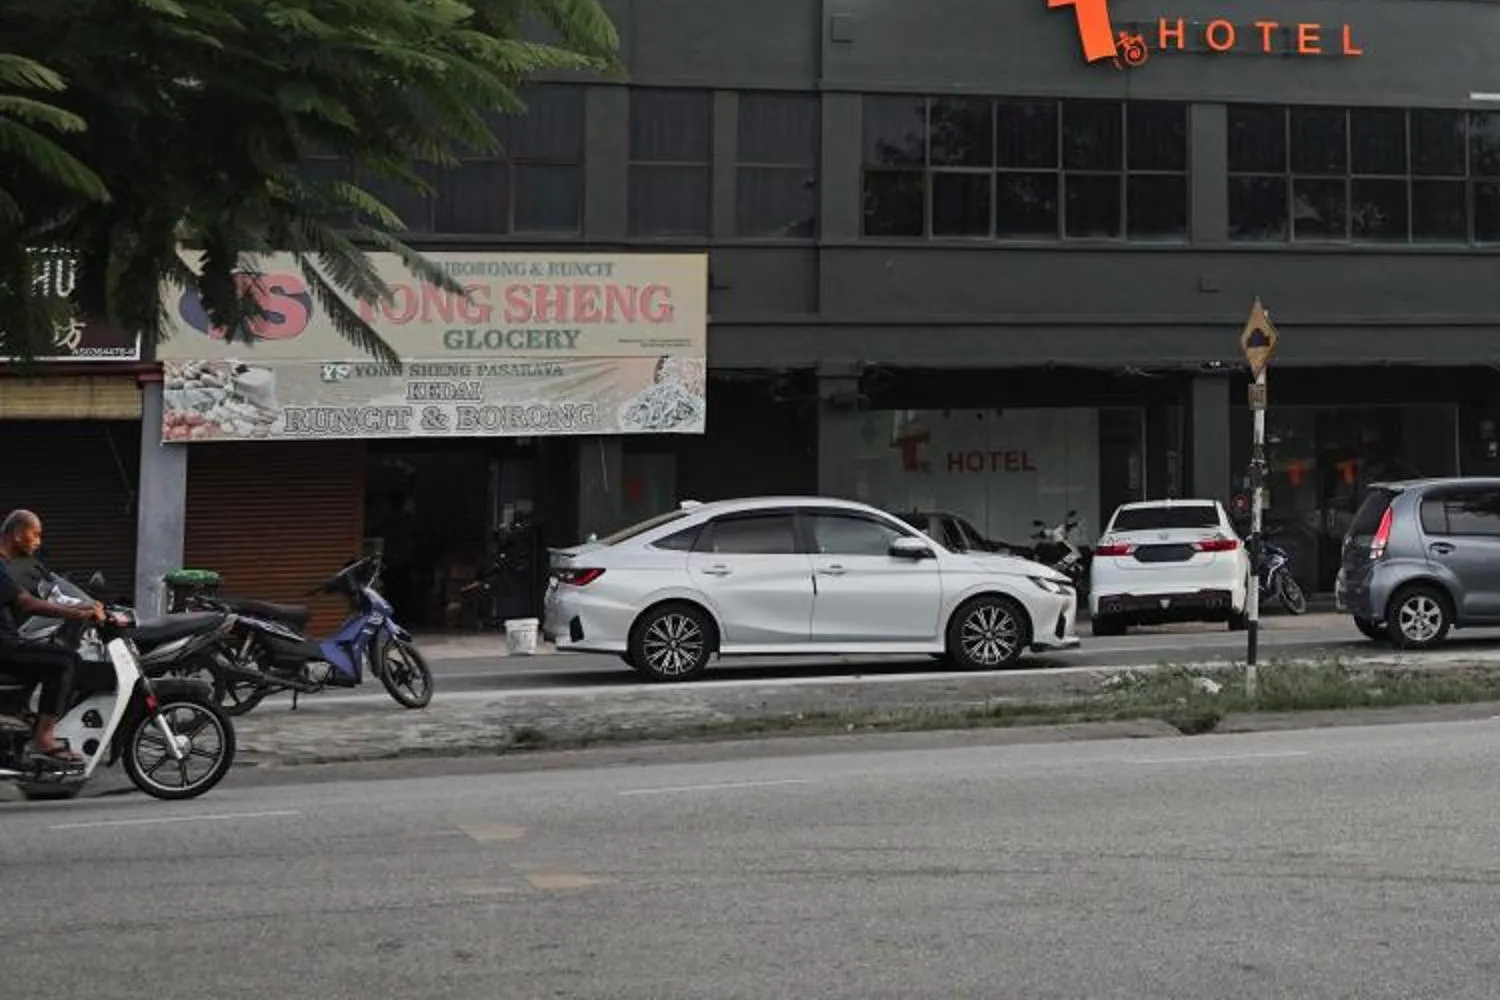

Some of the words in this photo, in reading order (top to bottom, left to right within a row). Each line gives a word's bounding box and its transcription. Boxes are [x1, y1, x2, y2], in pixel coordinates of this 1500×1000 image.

[1158, 16, 1363, 56] HOTEL
[550, 262, 616, 277] RUNCIT
[503, 282, 675, 325] SHENG
[442, 329, 581, 350] GLOCERY
[408, 363, 472, 378] SHENG
[407, 380, 484, 401] KEDAI
[283, 405, 413, 433] RUNCIT
[421, 405, 448, 431] &
[455, 403, 600, 431] BORONG
[947, 451, 1037, 473] HOTEL
